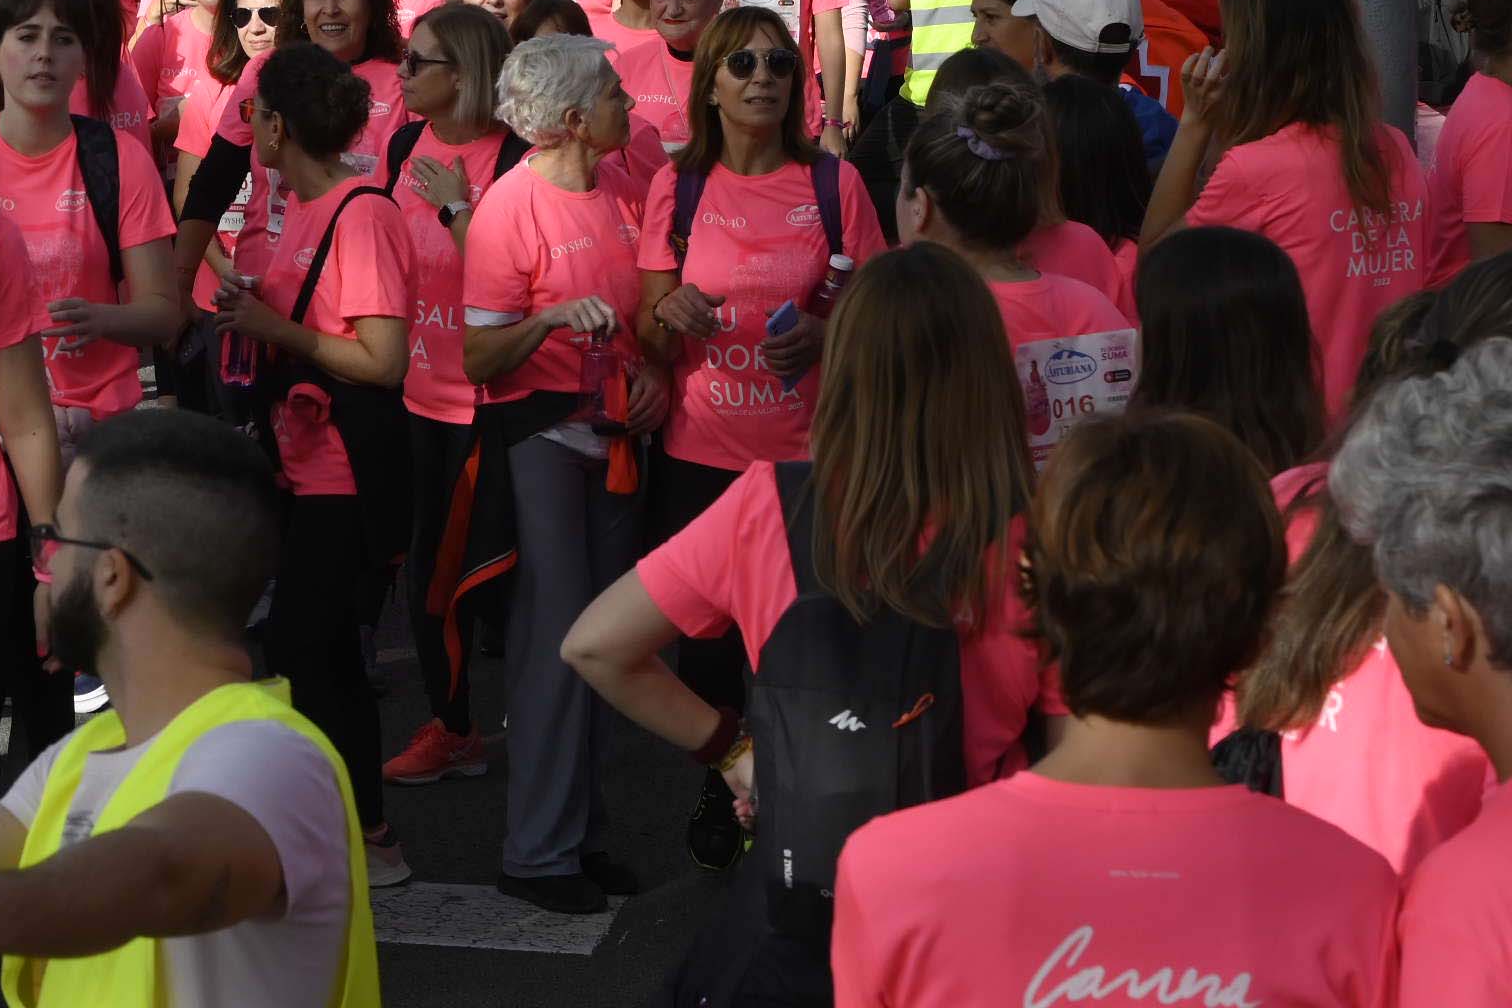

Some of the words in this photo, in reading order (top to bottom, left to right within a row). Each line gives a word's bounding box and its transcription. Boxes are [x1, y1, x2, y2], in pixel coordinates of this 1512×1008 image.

[550, 236, 593, 260] OYSHO
[1386, 225, 1410, 248] LA
[1345, 249, 1417, 278] MUJER
[414, 298, 459, 331] SAL
[706, 344, 769, 371] DOR
[1052, 394, 1096, 419] 016
